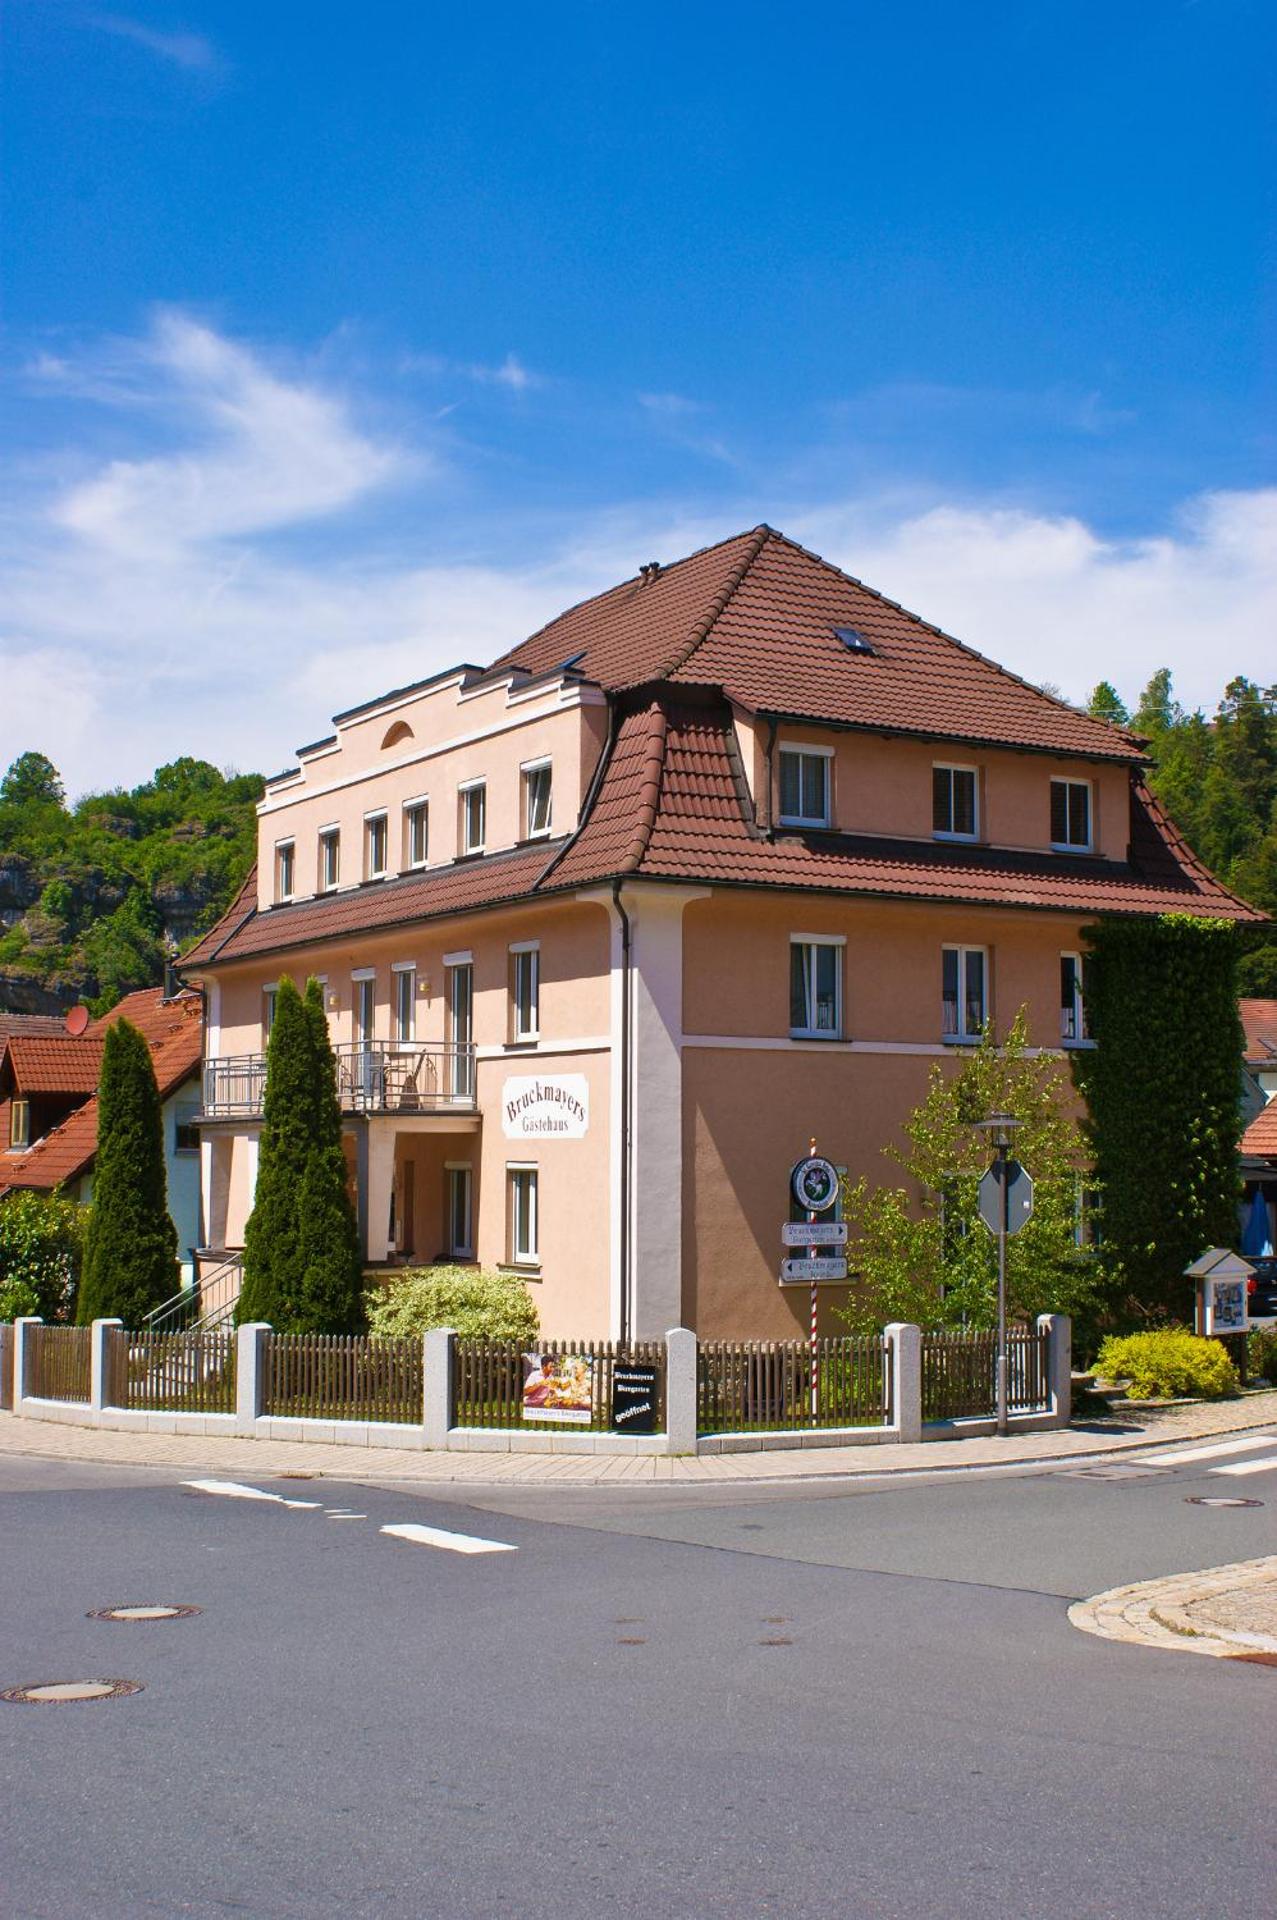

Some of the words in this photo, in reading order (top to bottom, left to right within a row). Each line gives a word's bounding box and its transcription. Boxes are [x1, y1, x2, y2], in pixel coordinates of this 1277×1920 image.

[506, 1080, 586, 1122] Bruckmayers
[521, 1115, 569, 1132] Gästehaus
[615, 1402, 651, 1423] geöffnet
